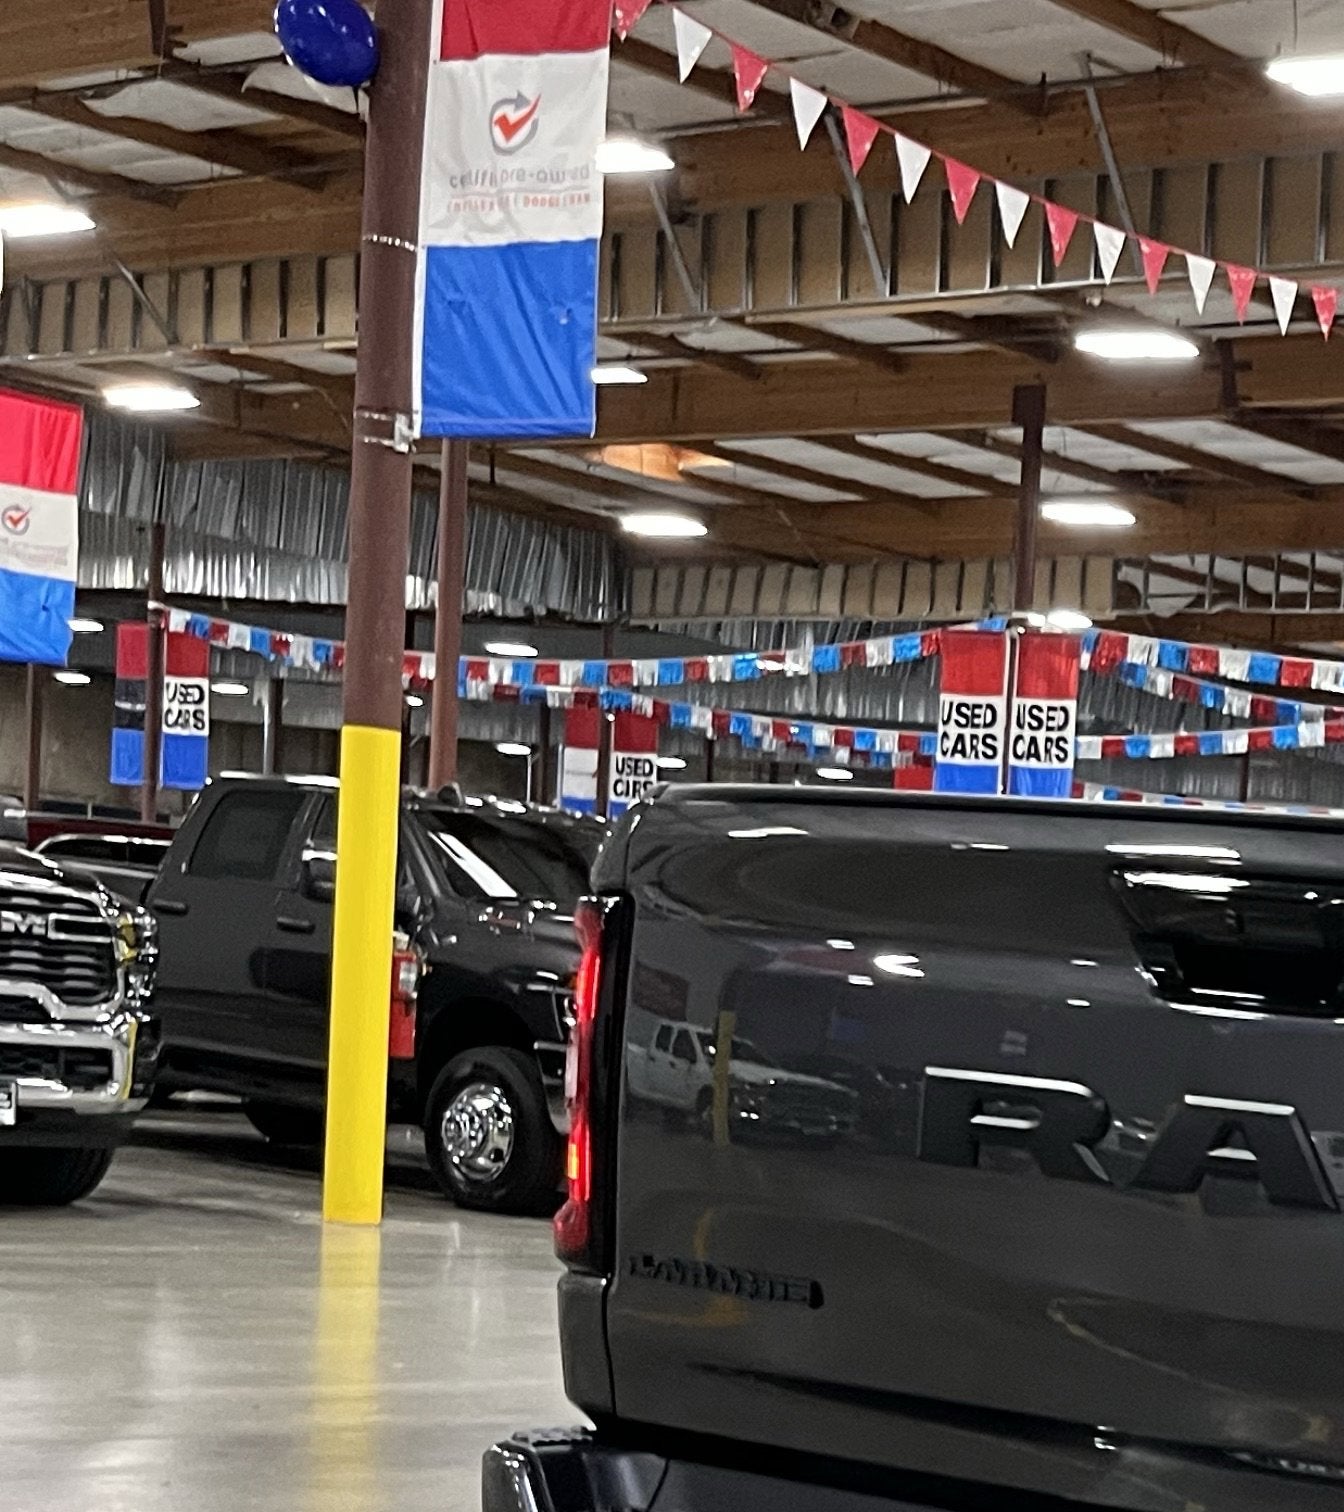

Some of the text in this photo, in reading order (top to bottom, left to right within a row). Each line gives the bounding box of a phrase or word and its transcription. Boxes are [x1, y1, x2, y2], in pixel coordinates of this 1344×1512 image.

[942, 701, 998, 729] USED
[1016, 704, 1069, 732] USED
[940, 731, 998, 760] CARS
[1012, 734, 1069, 764] CARS
[616, 756, 654, 777] USED
